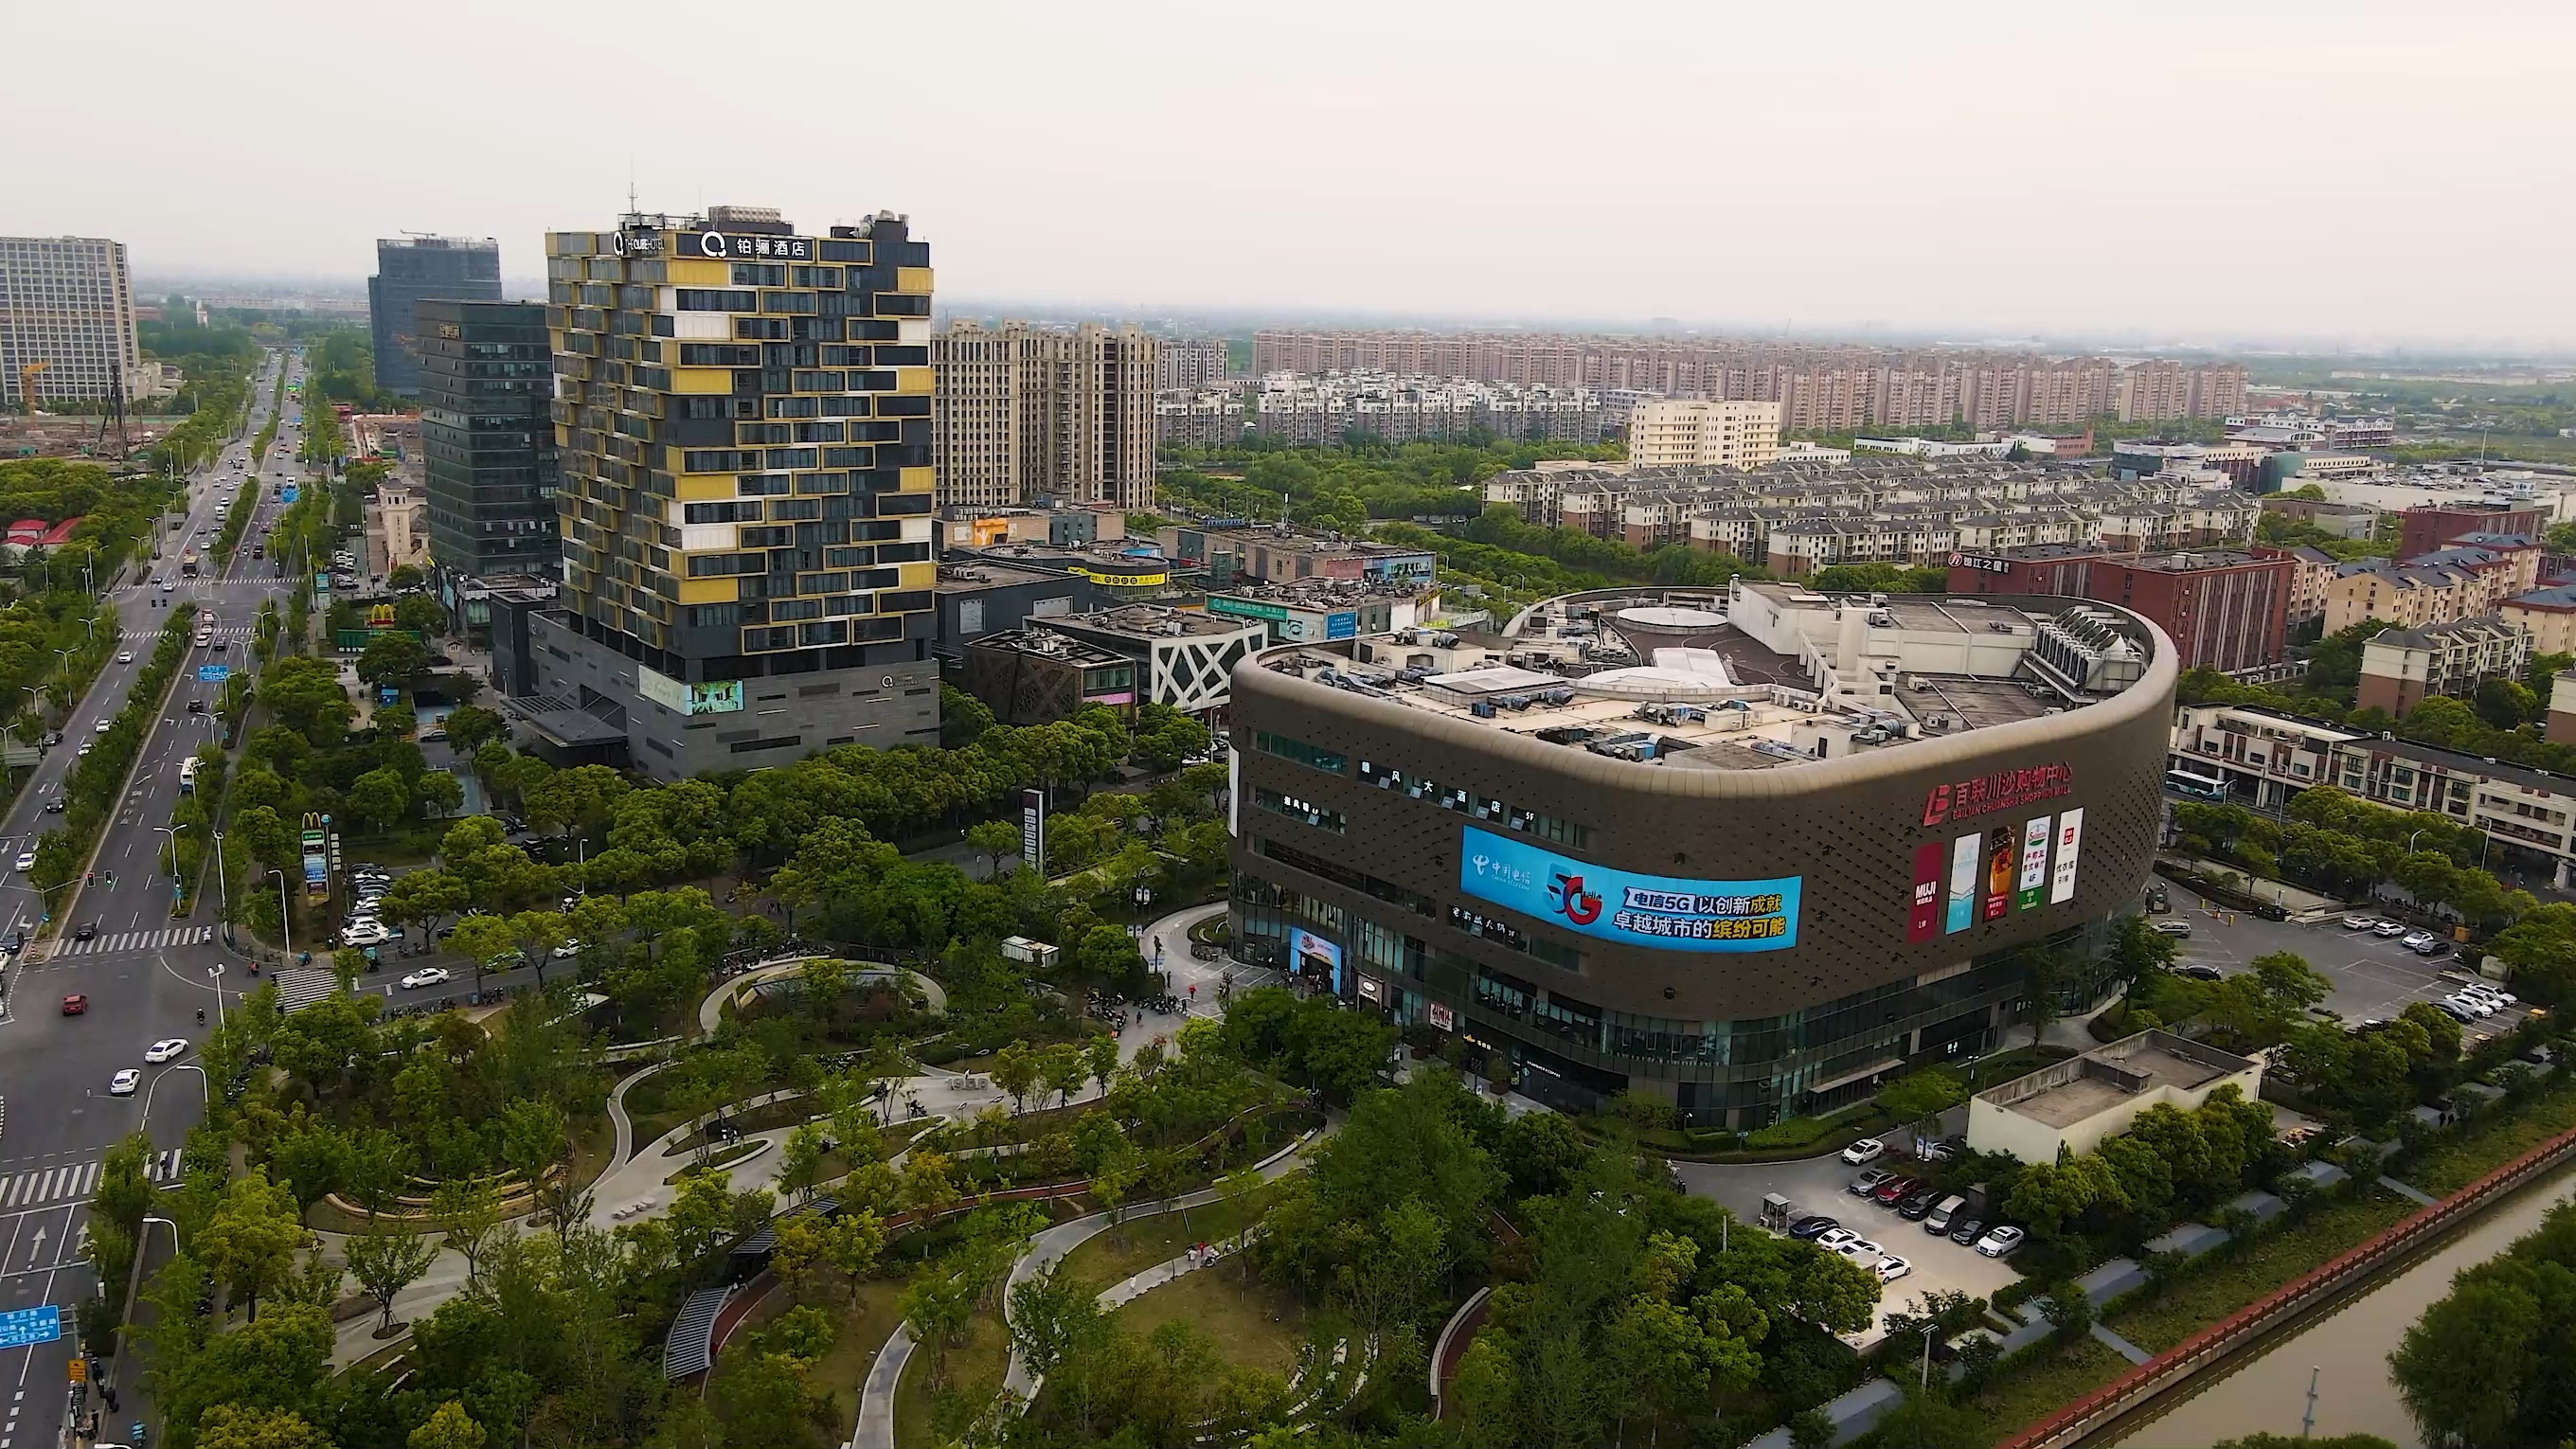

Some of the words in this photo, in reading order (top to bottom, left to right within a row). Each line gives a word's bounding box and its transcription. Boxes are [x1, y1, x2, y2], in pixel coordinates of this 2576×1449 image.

[737, 238, 805, 257] 铂骊酒店
[1963, 556, 2002, 572] 锦江之星
[1955, 761, 2073, 808] 百联川沙购物中心
[1952, 807, 1980, 821] BAILIAN
[1981, 797, 2019, 815] CHUANSHA
[2020, 789, 2054, 806] SHOPPING
[2053, 784, 2072, 797] MALL
[1492, 861, 1531, 886] 中国电信
[2029, 873, 2036, 883] 4F
[1915, 881, 1937, 900] MUJI
[1698, 894, 1782, 915] 以创新成就
[1614, 910, 1786, 939] 卓越城市的缤纷可能
